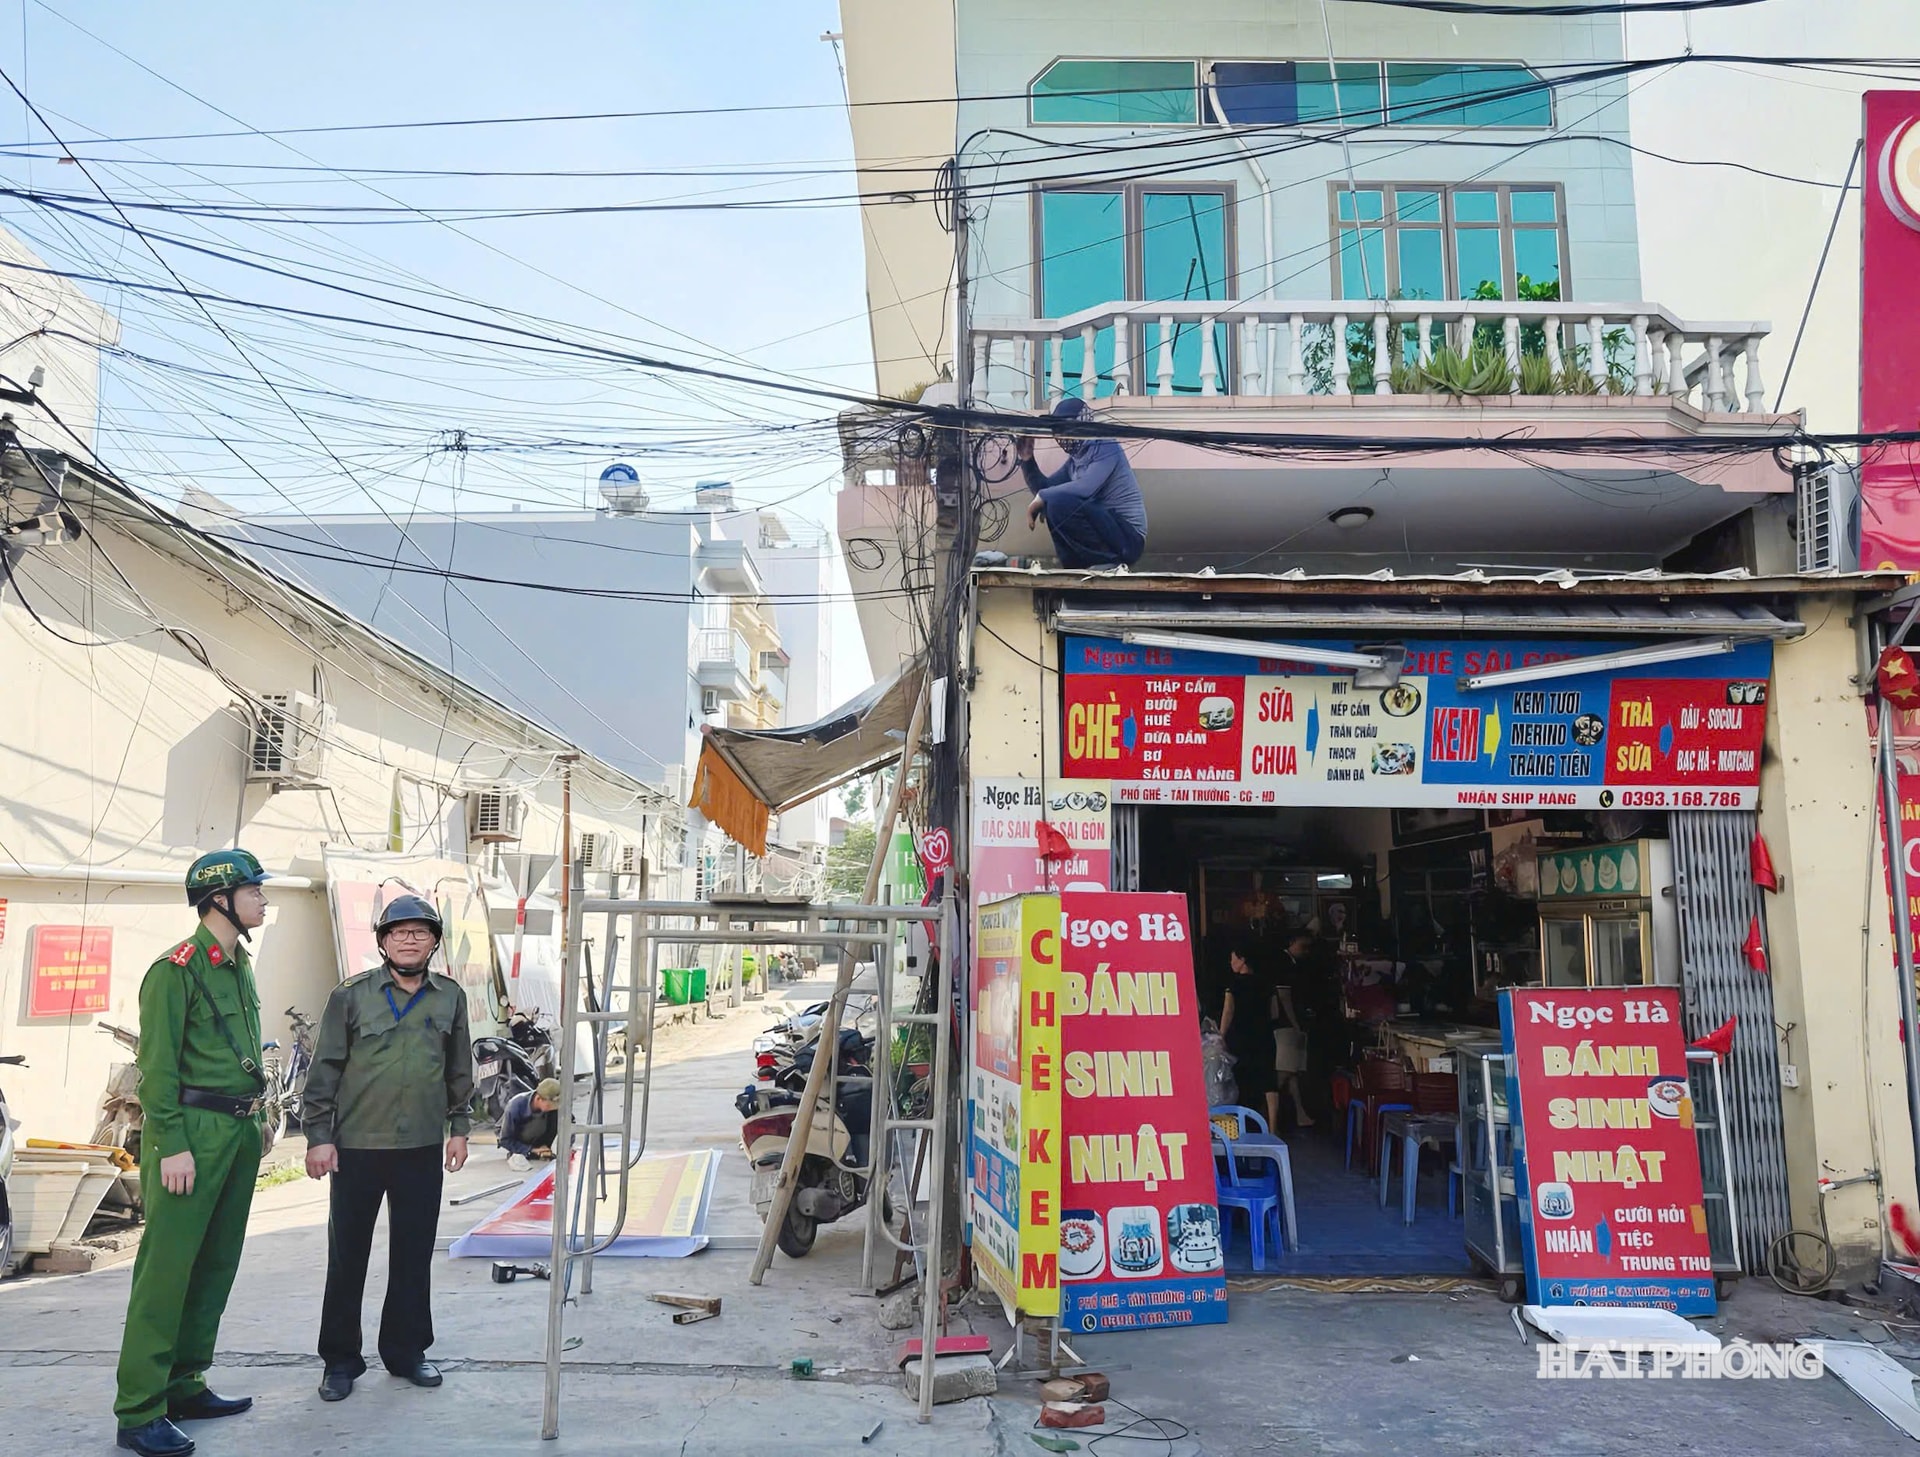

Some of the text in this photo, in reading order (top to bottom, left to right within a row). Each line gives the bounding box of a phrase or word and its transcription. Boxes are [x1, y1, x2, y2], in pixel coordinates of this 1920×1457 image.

[1084, 646, 1137, 669] Ngọc
[1145, 679, 1180, 695] THẬP
[1512, 690, 1581, 715] KEM TƯƠI
[1258, 686, 1294, 722] SỮA
[1620, 695, 1654, 728] TRÀ
[1707, 707, 1743, 730] SOCOLA
[1068, 691, 1121, 760] CHÈ
[1431, 706, 1481, 763] KEM
[1510, 722, 1567, 747] MERINO
[1143, 750, 1162, 762] BƠ
[1251, 744, 1297, 775] CHUA
[1616, 740, 1653, 772] SỮA
[985, 784, 1041, 811] Ngọc Hà
[1502, 792, 1534, 805] SHIP
[1622, 791, 1741, 807] 0393.168.786
[1138, 911, 1186, 942] Hà
[1061, 962, 1180, 1016] BÁNH
[1528, 1000, 1670, 1029] Ngọc Hà
[1064, 1050, 1173, 1098] SINH
[1542, 1040, 1660, 1077] BÁNH
[1548, 1097, 1652, 1130] SINH
[1069, 1123, 1188, 1192] NHẬT
[1552, 1144, 1666, 1189] NHẬT
[1614, 1203, 1686, 1223] CƯỚI HỎI
[1544, 1225, 1594, 1258] NHẬN
[1617, 1229, 1654, 1250] TIỆC
[1620, 1255, 1711, 1271] TRUNG THU
